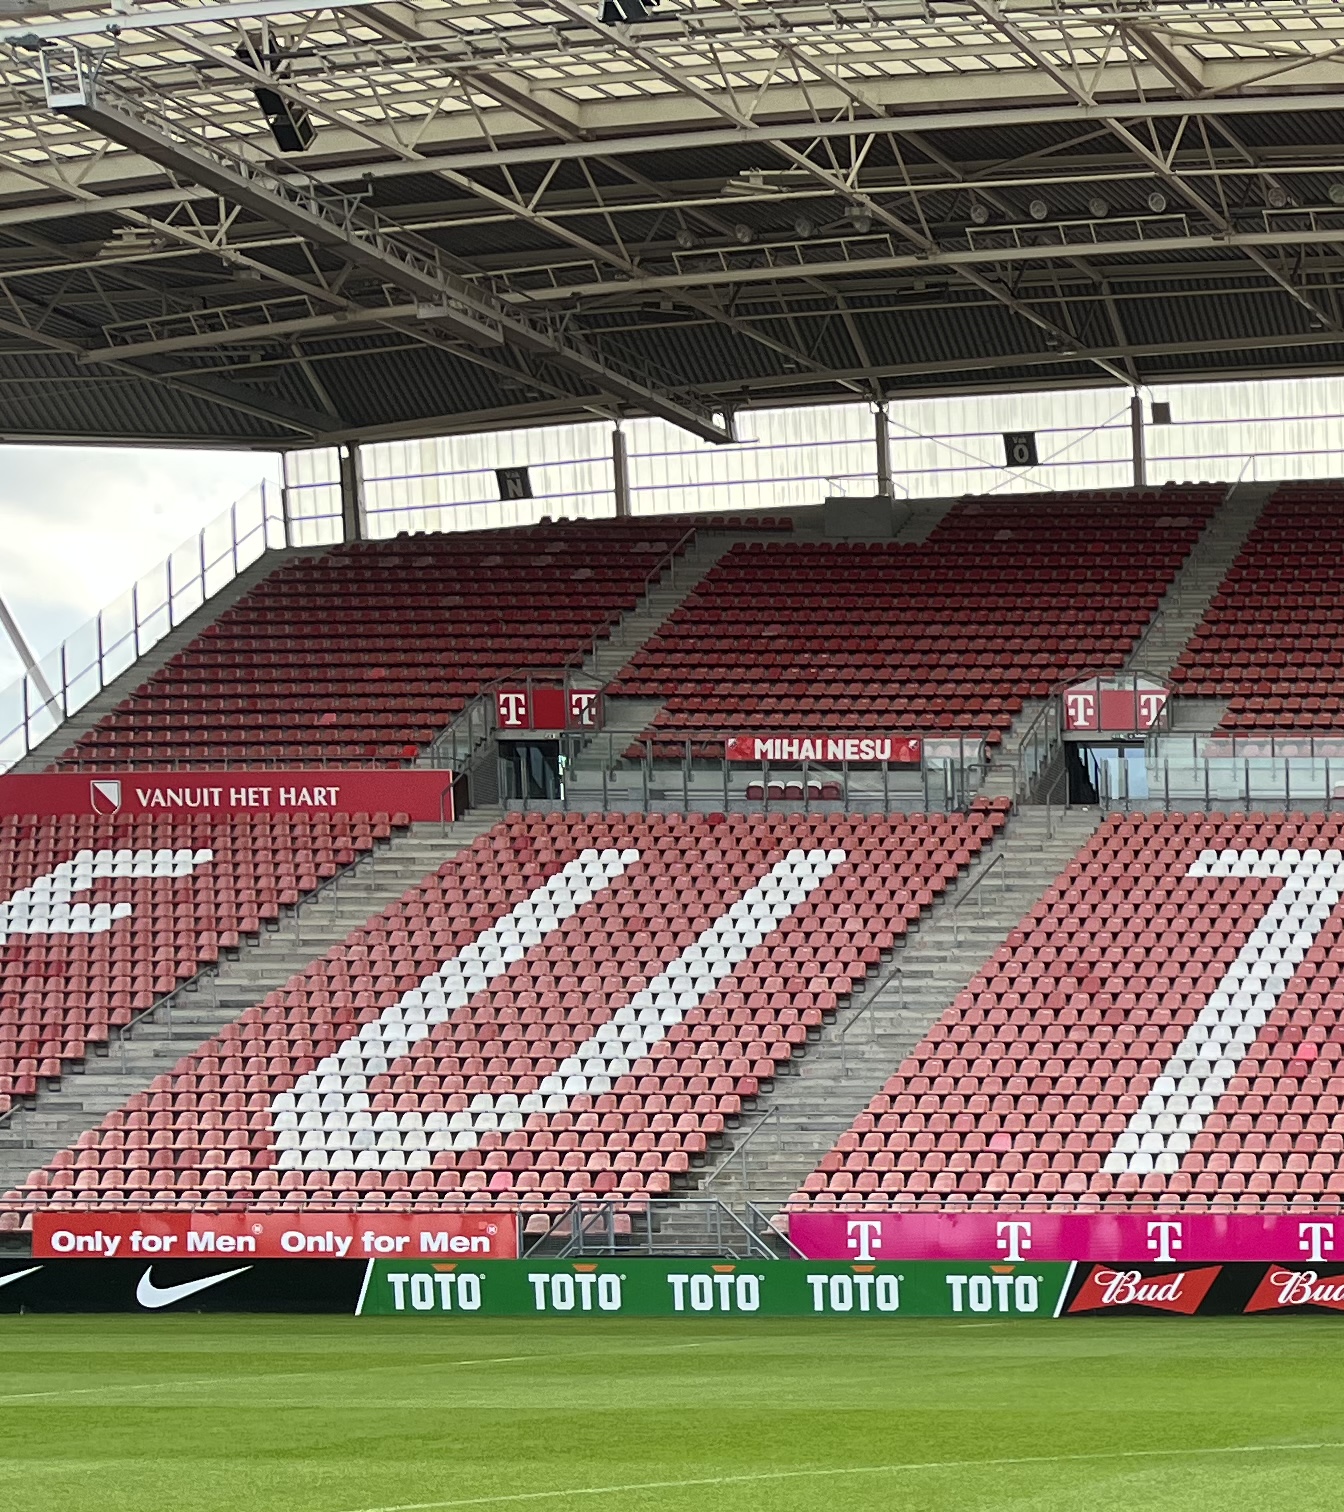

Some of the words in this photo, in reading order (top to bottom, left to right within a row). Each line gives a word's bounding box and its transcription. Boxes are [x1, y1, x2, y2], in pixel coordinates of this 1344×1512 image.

[1013, 444, 1029, 464] O
[506, 478, 524, 498] N
[754, 738, 822, 760] MIHAI
[827, 738, 891, 760] NESU
[136, 788, 223, 807] VANUIT
[230, 787, 273, 806] HET
[279, 787, 340, 806] HART
[51, 1230, 121, 1256] Only
[129, 1230, 177, 1252] for
[187, 1231, 255, 1252] Men
[281, 1230, 353, 1257] Only
[361, 1230, 409, 1252] for
[420, 1231, 490, 1253] Men
[387, 1273, 482, 1310] TOTO
[528, 1273, 622, 1310] TOTO
[667, 1274, 760, 1311] TOTO
[807, 1274, 899, 1312] TOTO
[946, 1275, 1038, 1312] TOTO
[1094, 1270, 1183, 1304] Bud
